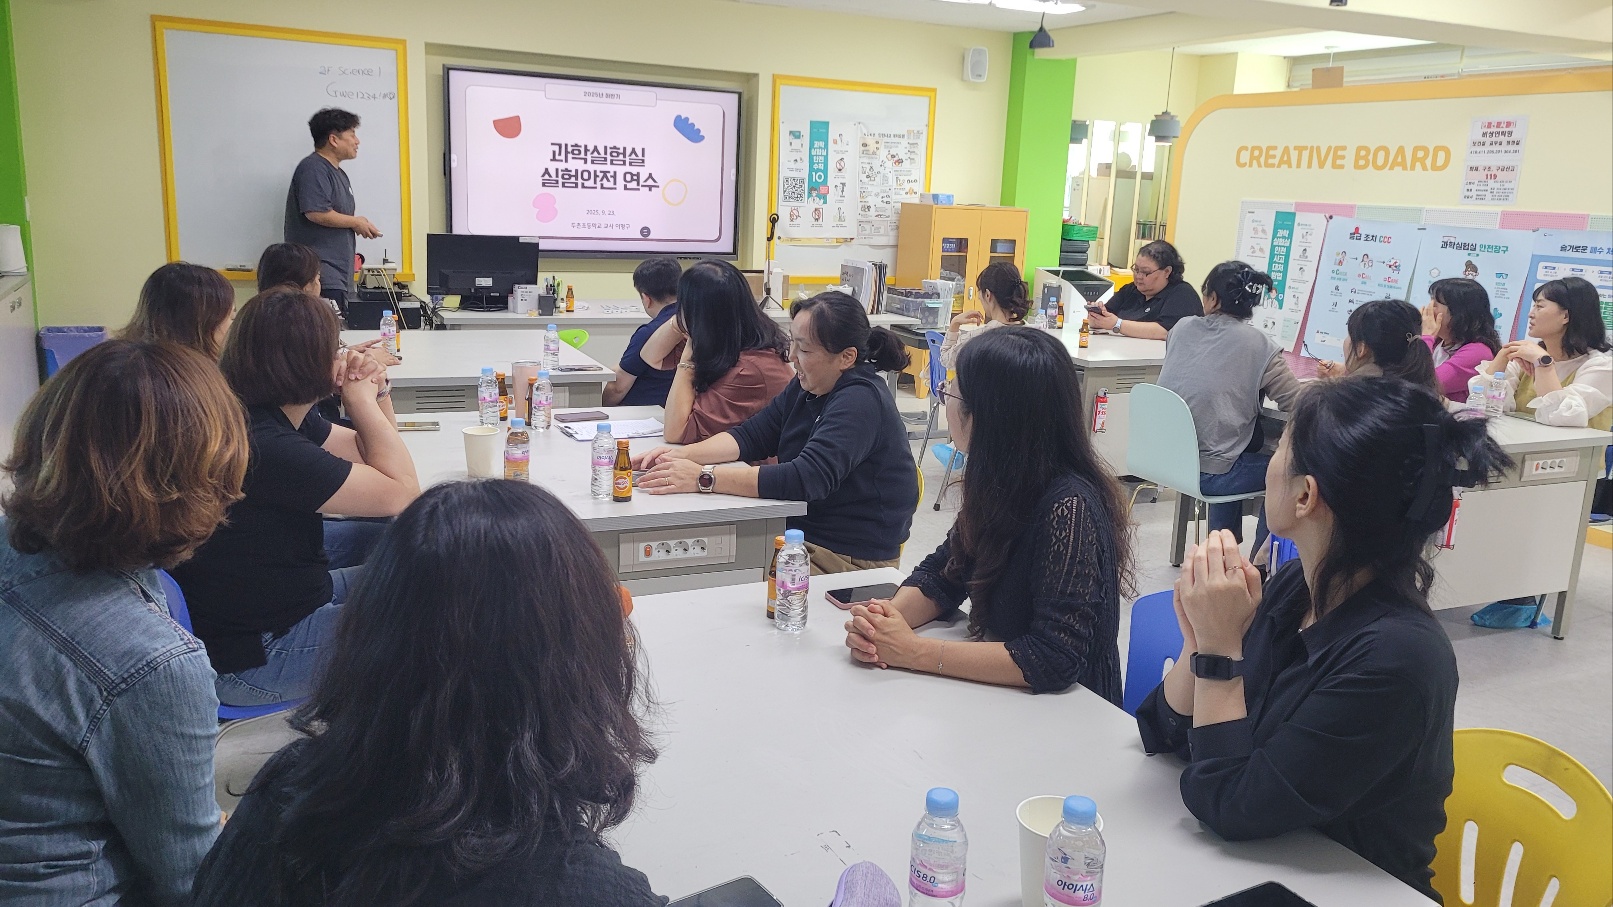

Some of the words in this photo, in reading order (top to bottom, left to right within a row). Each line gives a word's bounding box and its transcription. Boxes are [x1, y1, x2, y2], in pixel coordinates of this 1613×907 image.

[338, 66, 374, 76] Science
[550, 142, 646, 167] 과학실험실
[1235, 145, 1347, 170] CREATIVE
[1353, 145, 1452, 172] BOARD
[541, 168, 617, 190] 실험안전
[623, 171, 659, 192] 연수
[812, 172, 824, 182] 10
[1363, 234, 1377, 242] 조치
[1379, 236, 1391, 244] CCC
[1440, 240, 1477, 251] 과학실험실
[1480, 244, 1509, 254] 안전장구
[1560, 244, 1588, 253] 슬기로운
[1056, 879, 1095, 894] 아이시스
